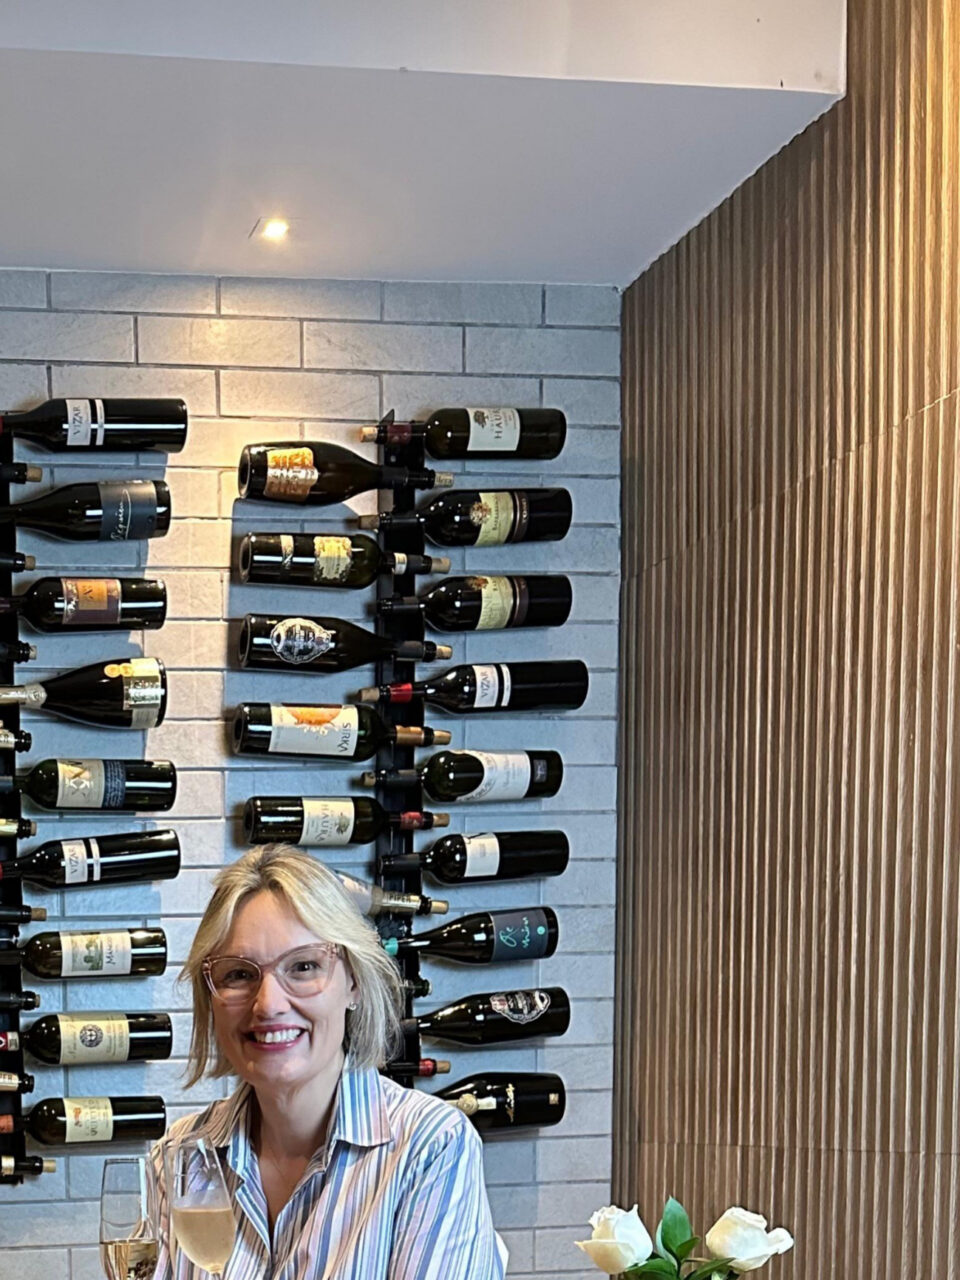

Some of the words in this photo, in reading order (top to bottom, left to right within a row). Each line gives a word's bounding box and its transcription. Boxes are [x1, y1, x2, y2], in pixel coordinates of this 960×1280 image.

[72, 405, 83, 435] VIZAR
[479, 671, 491, 699] VIZAR
[337, 722, 352, 753] SIRKA
